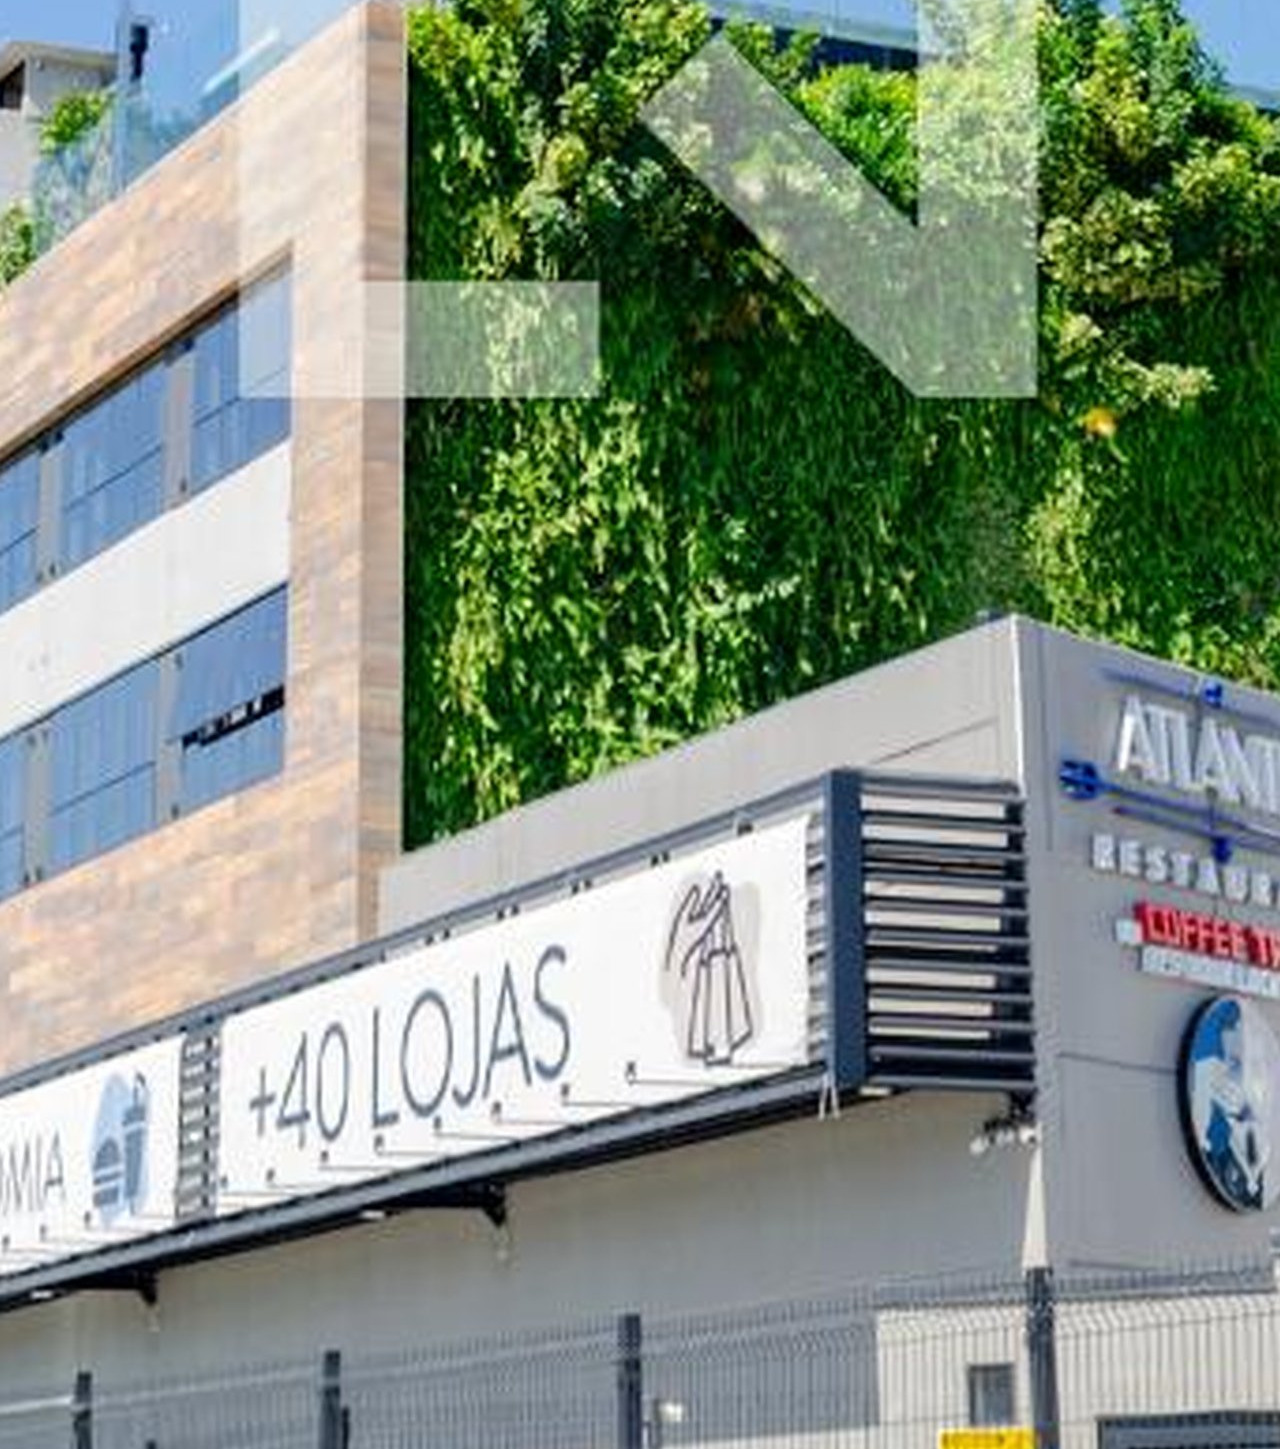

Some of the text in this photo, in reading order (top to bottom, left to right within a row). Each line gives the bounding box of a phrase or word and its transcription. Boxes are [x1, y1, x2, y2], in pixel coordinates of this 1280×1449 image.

[1144, 903, 1247, 960] COFFEE
[249, 944, 571, 1149] +40 LOJAS
